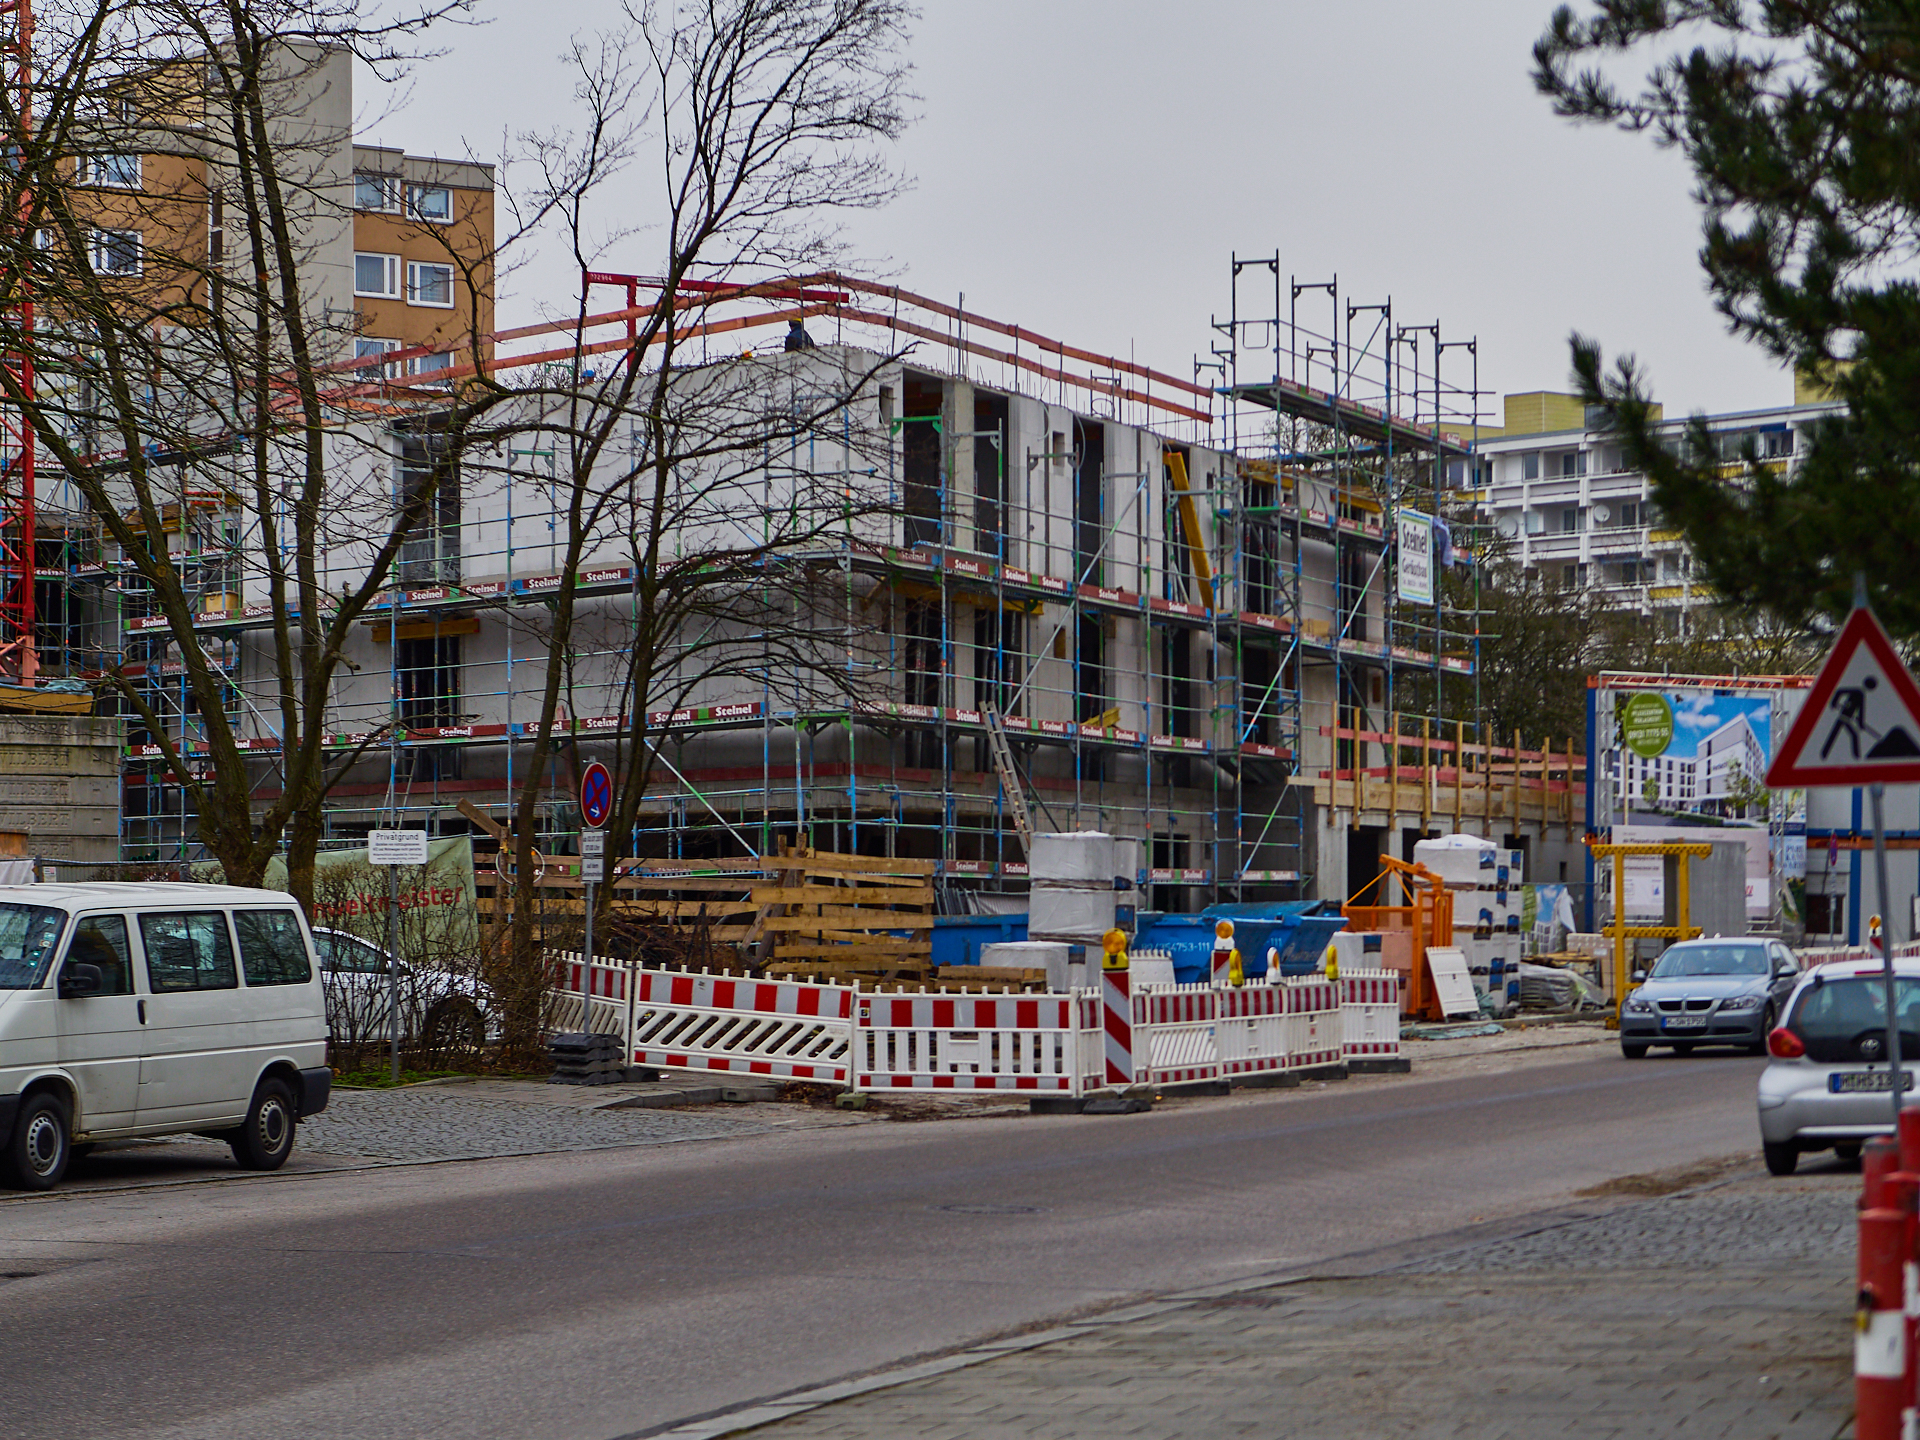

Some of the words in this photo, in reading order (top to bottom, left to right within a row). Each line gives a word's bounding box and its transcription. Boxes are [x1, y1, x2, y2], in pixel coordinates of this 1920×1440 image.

[1403, 522, 1427, 554] Steinel
[954, 559, 979, 573] Steinel
[586, 570, 621, 582] Steinel
[1005, 569, 1028, 583] Steinel
[466, 583, 498, 594] Steinel
[1042, 576, 1064, 590] Steinel
[412, 590, 443, 600] Steinel
[1098, 588, 1120, 601] Steinel
[1168, 601, 1188, 614] Steinel
[142, 616, 168, 628] Steinel
[199, 610, 227, 622] Steinel
[715, 704, 752, 717] Steinel
[956, 710, 980, 723] Steinel
[1005, 716, 1028, 729] Steinel
[1042, 721, 1064, 732] Steinel
[1081, 725, 1103, 737] Steinel
[1115, 730, 1136, 742] Steinel
[1152, 735, 1173, 747] Steinel
[1183, 738, 1203, 749] Steinel
[1257, 745, 1276, 756] Steinel
[375, 832, 419, 842] Privatgrund
[956, 861, 979, 871] Steinel
[1005, 863, 1028, 874] Steinel
